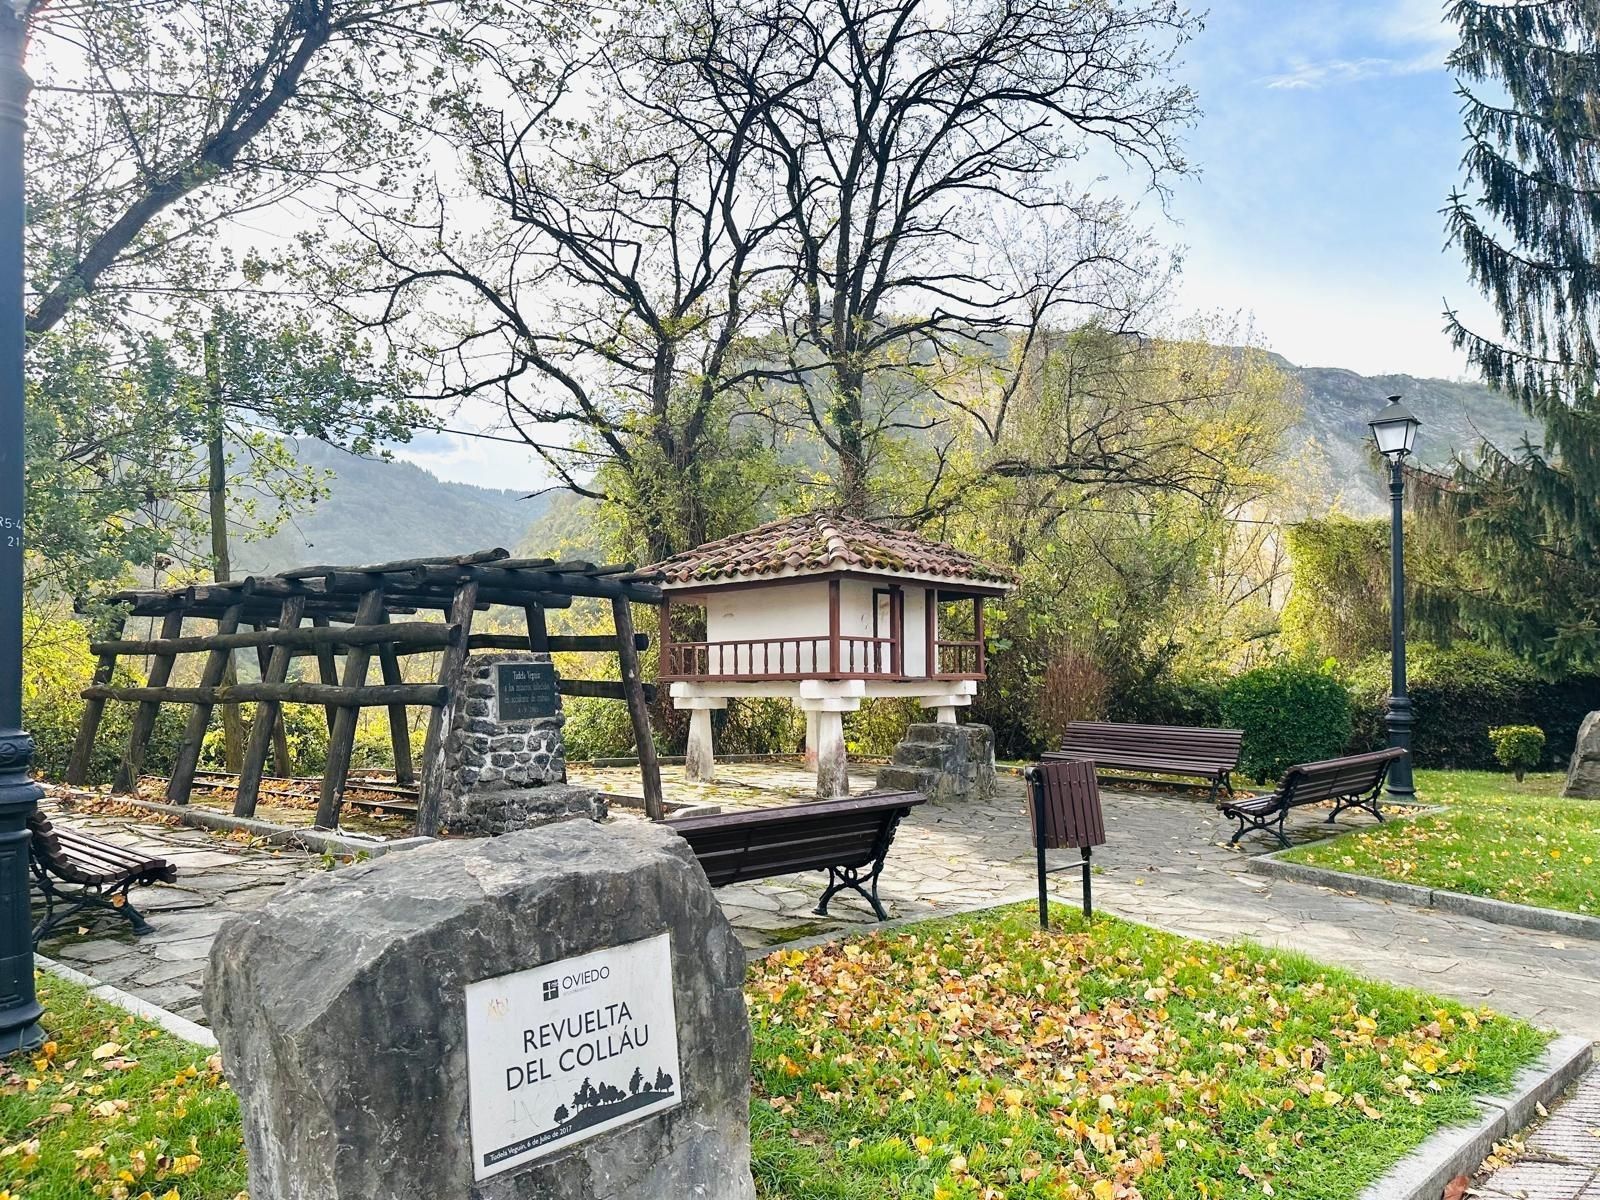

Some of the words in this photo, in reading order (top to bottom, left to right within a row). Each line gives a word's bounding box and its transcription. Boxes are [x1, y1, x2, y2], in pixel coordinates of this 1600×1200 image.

[7, 535, 20, 548] 21
[562, 965, 610, 990] OVIEDO
[523, 1001, 633, 1054] REVUELTA
[506, 1058, 552, 1092] DEL
[558, 1024, 650, 1073] COLLÁU
[489, 1150, 507, 1161] Tudela
[527, 1140, 531, 1148] 6
[532, 1138, 539, 1146] de
[539, 1134, 552, 1145] Julio
[559, 1125, 572, 1135] 2017
